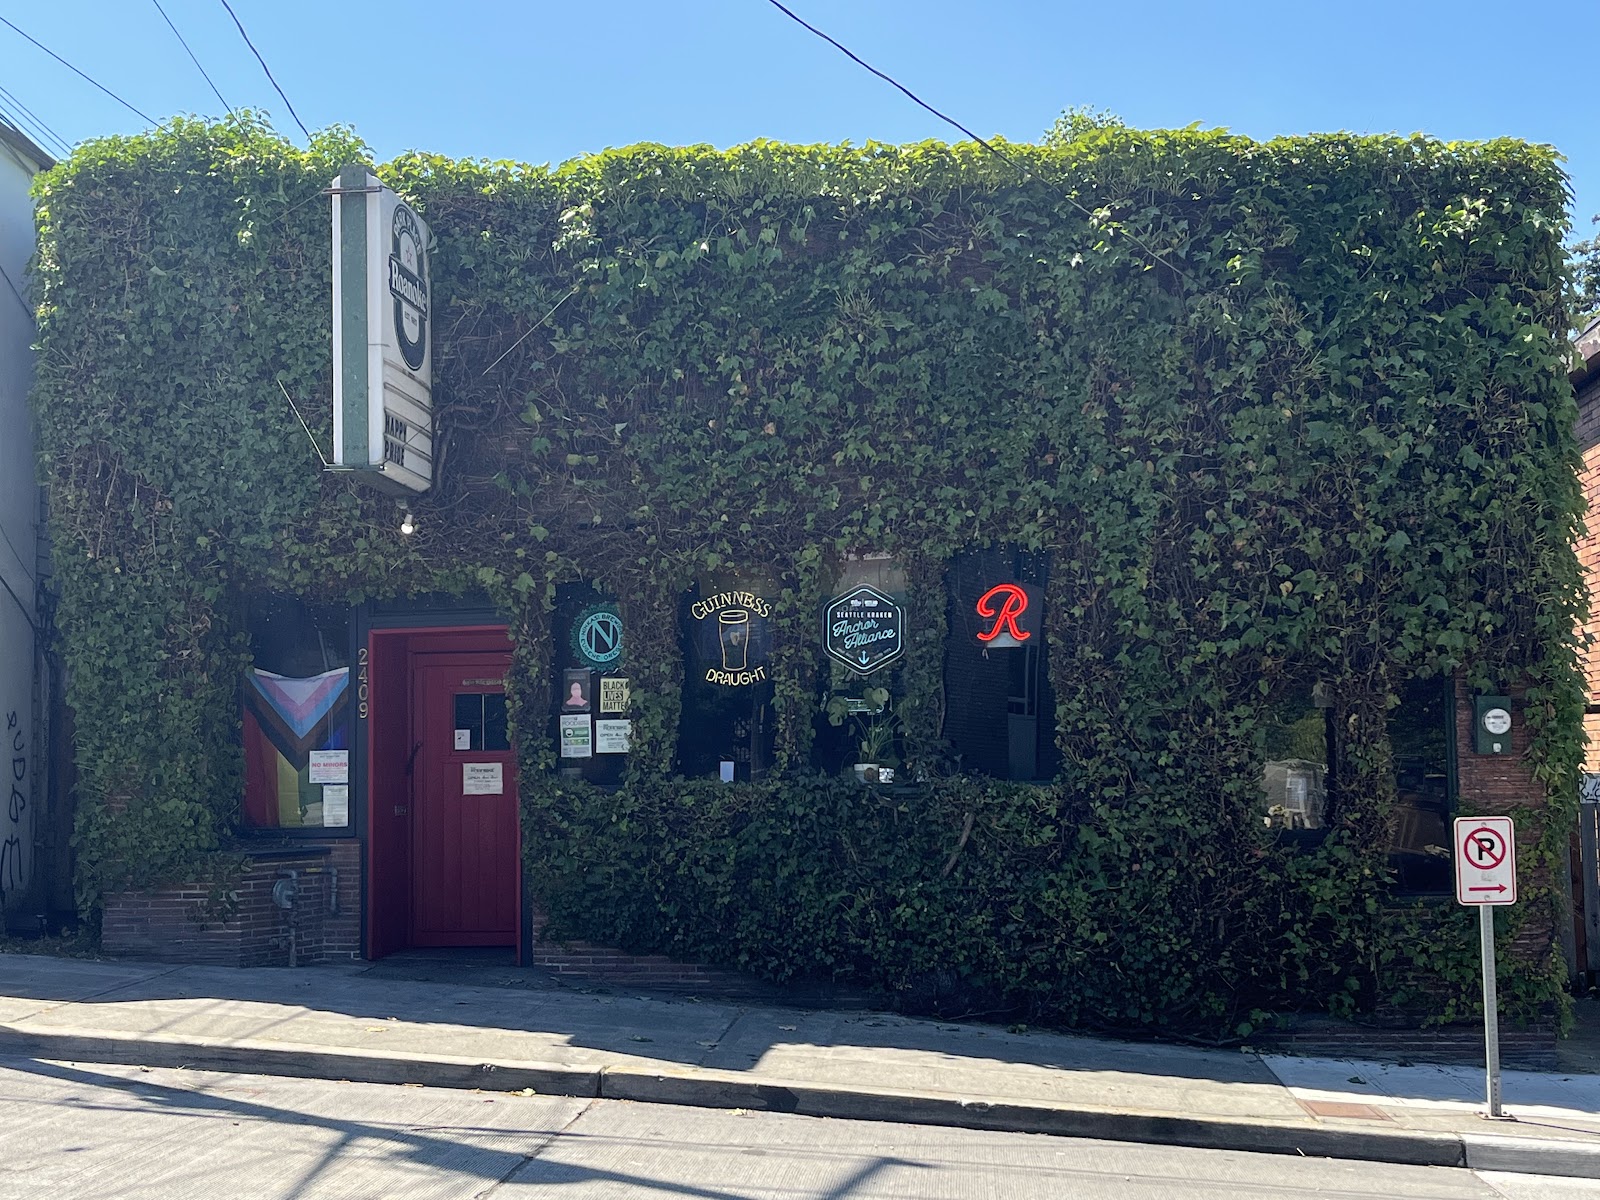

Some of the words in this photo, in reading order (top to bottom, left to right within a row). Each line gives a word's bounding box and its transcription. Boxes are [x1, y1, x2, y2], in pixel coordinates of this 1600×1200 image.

[391, 259, 427, 313] Roanoke
[385, 414, 407, 443] HAPPY
[691, 591, 772, 619] GUINNESS
[976, 583, 1031, 641] R
[832, 619, 879, 637] Anchor
[844, 628, 896, 649] Alliance
[358, 648, 369, 719] 2409
[602, 681, 625, 690] BLACK
[705, 666, 766, 686] DRAUGHT
[603, 691, 623, 701] LIVES
[1477, 837, 1495, 861] P
